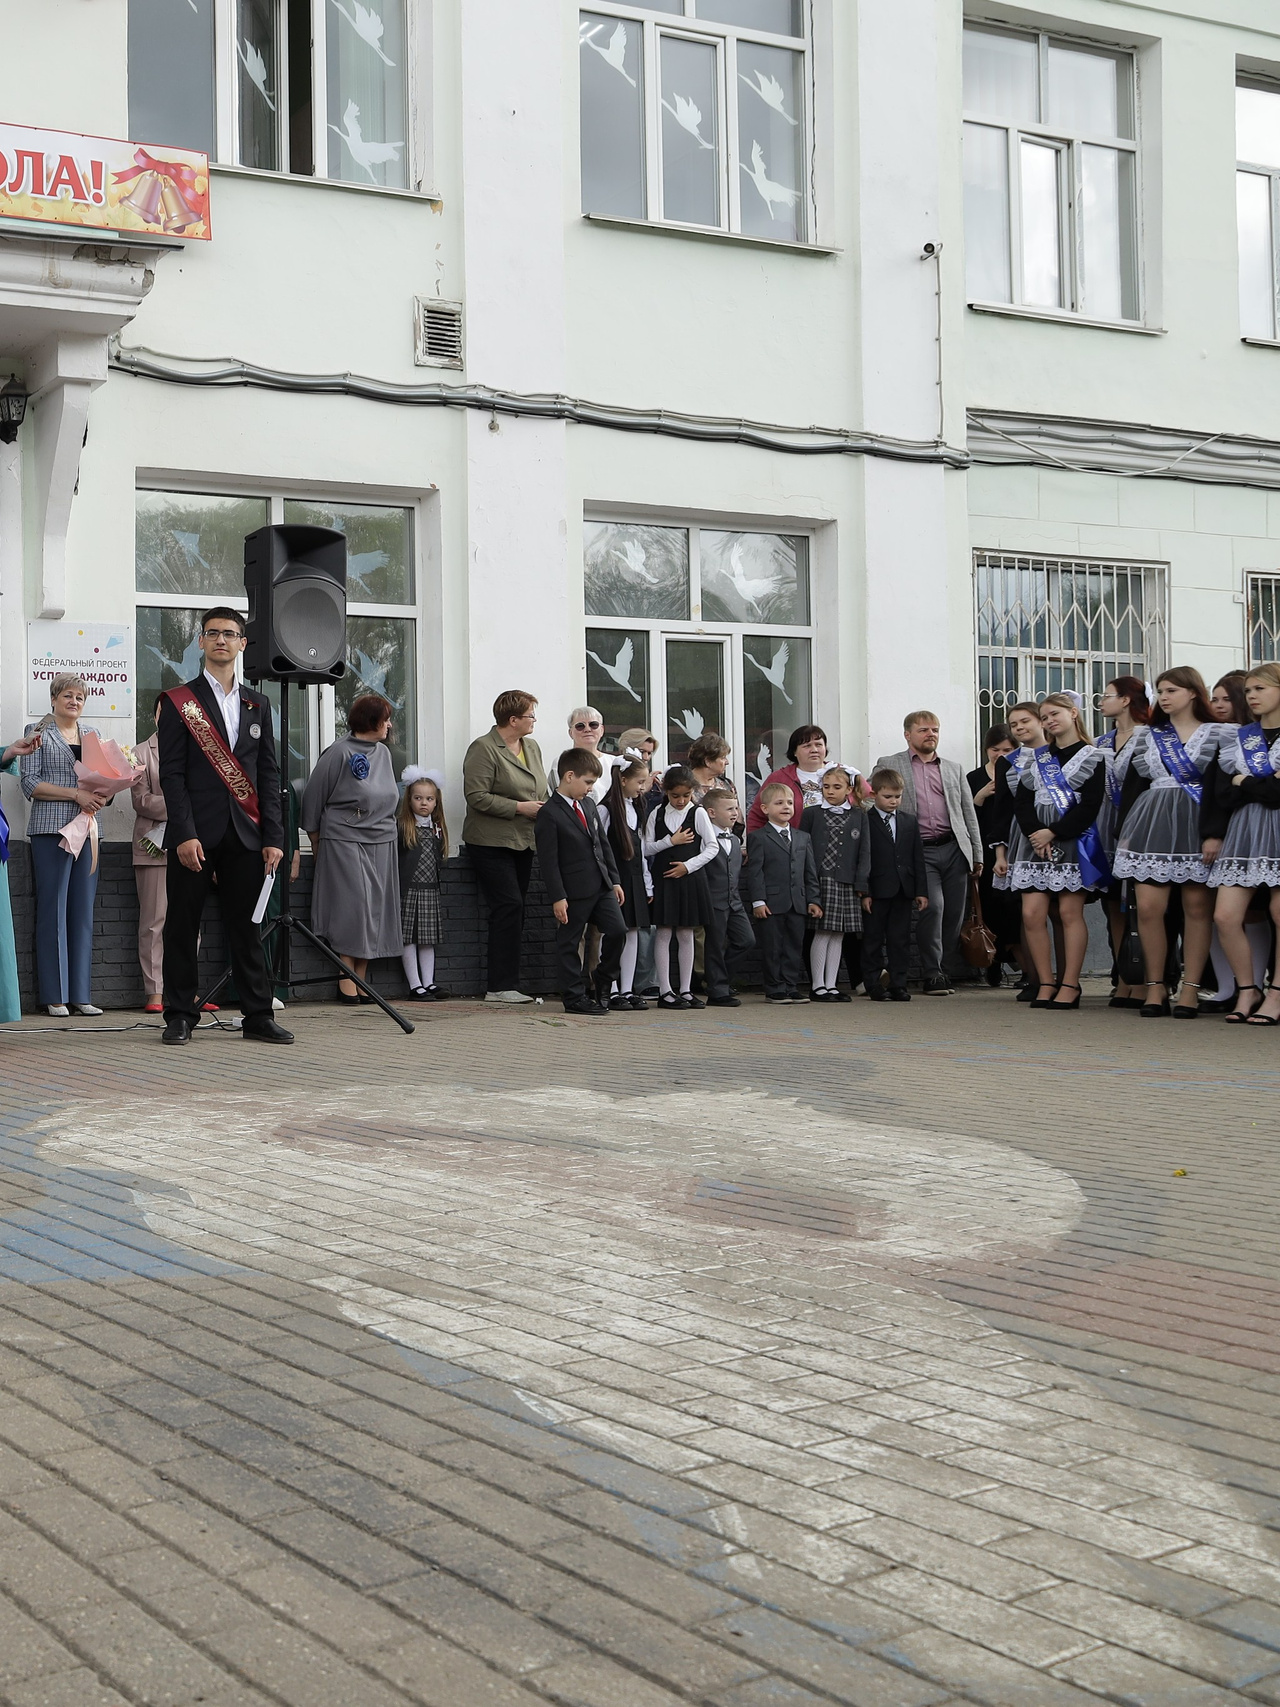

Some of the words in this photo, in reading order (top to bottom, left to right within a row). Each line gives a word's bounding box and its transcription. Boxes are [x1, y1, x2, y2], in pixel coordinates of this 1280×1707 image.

[32, 658, 94, 668] ФЕДЕРАЛЬНЫЙ
[96, 660, 128, 668] ПРОЕКТ
[77, 672, 128, 684] АЖДОГО
[191, 718, 235, 777] Выпускник
[224, 769, 254, 801] 2025
